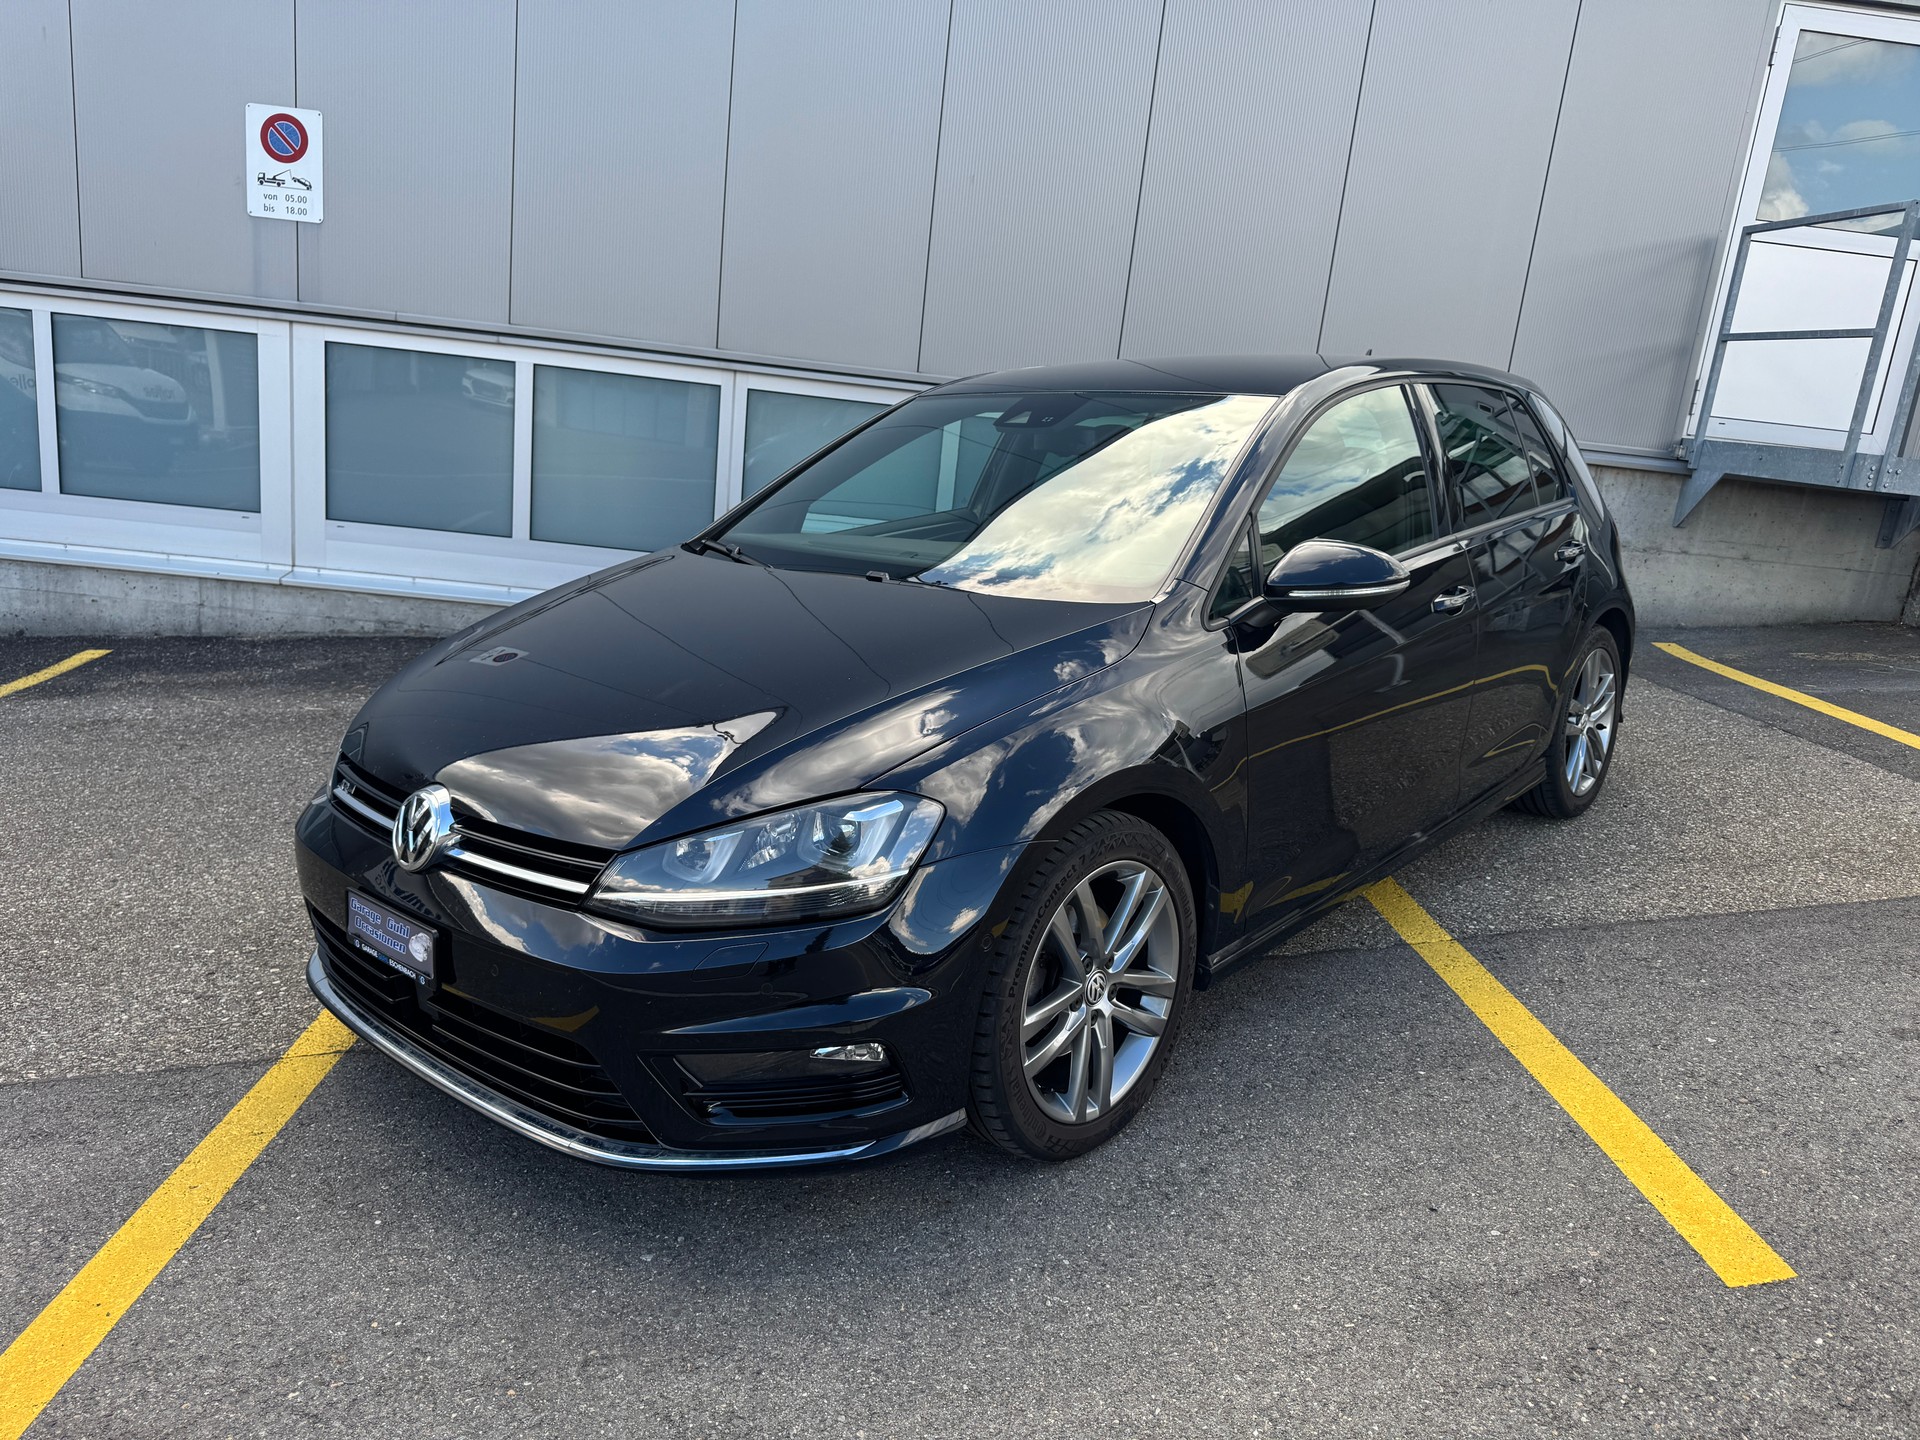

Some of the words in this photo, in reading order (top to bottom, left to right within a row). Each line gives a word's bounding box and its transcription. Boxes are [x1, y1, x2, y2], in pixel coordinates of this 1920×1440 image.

[263, 203, 275, 212] bis
[286, 206, 307, 216] 18.00
[285, 194, 307, 204] 05.00
[351, 897, 382, 925] Garage
[387, 916, 410, 939] Guhl
[355, 915, 408, 955] Occasionen
[1008, 864, 1077, 998] PremiumContact
[1079, 854, 1087, 865] 7
[361, 943, 379, 959] GARAGE
[388, 958, 417, 980] ESCHENBACH
[1009, 1076, 1046, 1139] Continental
